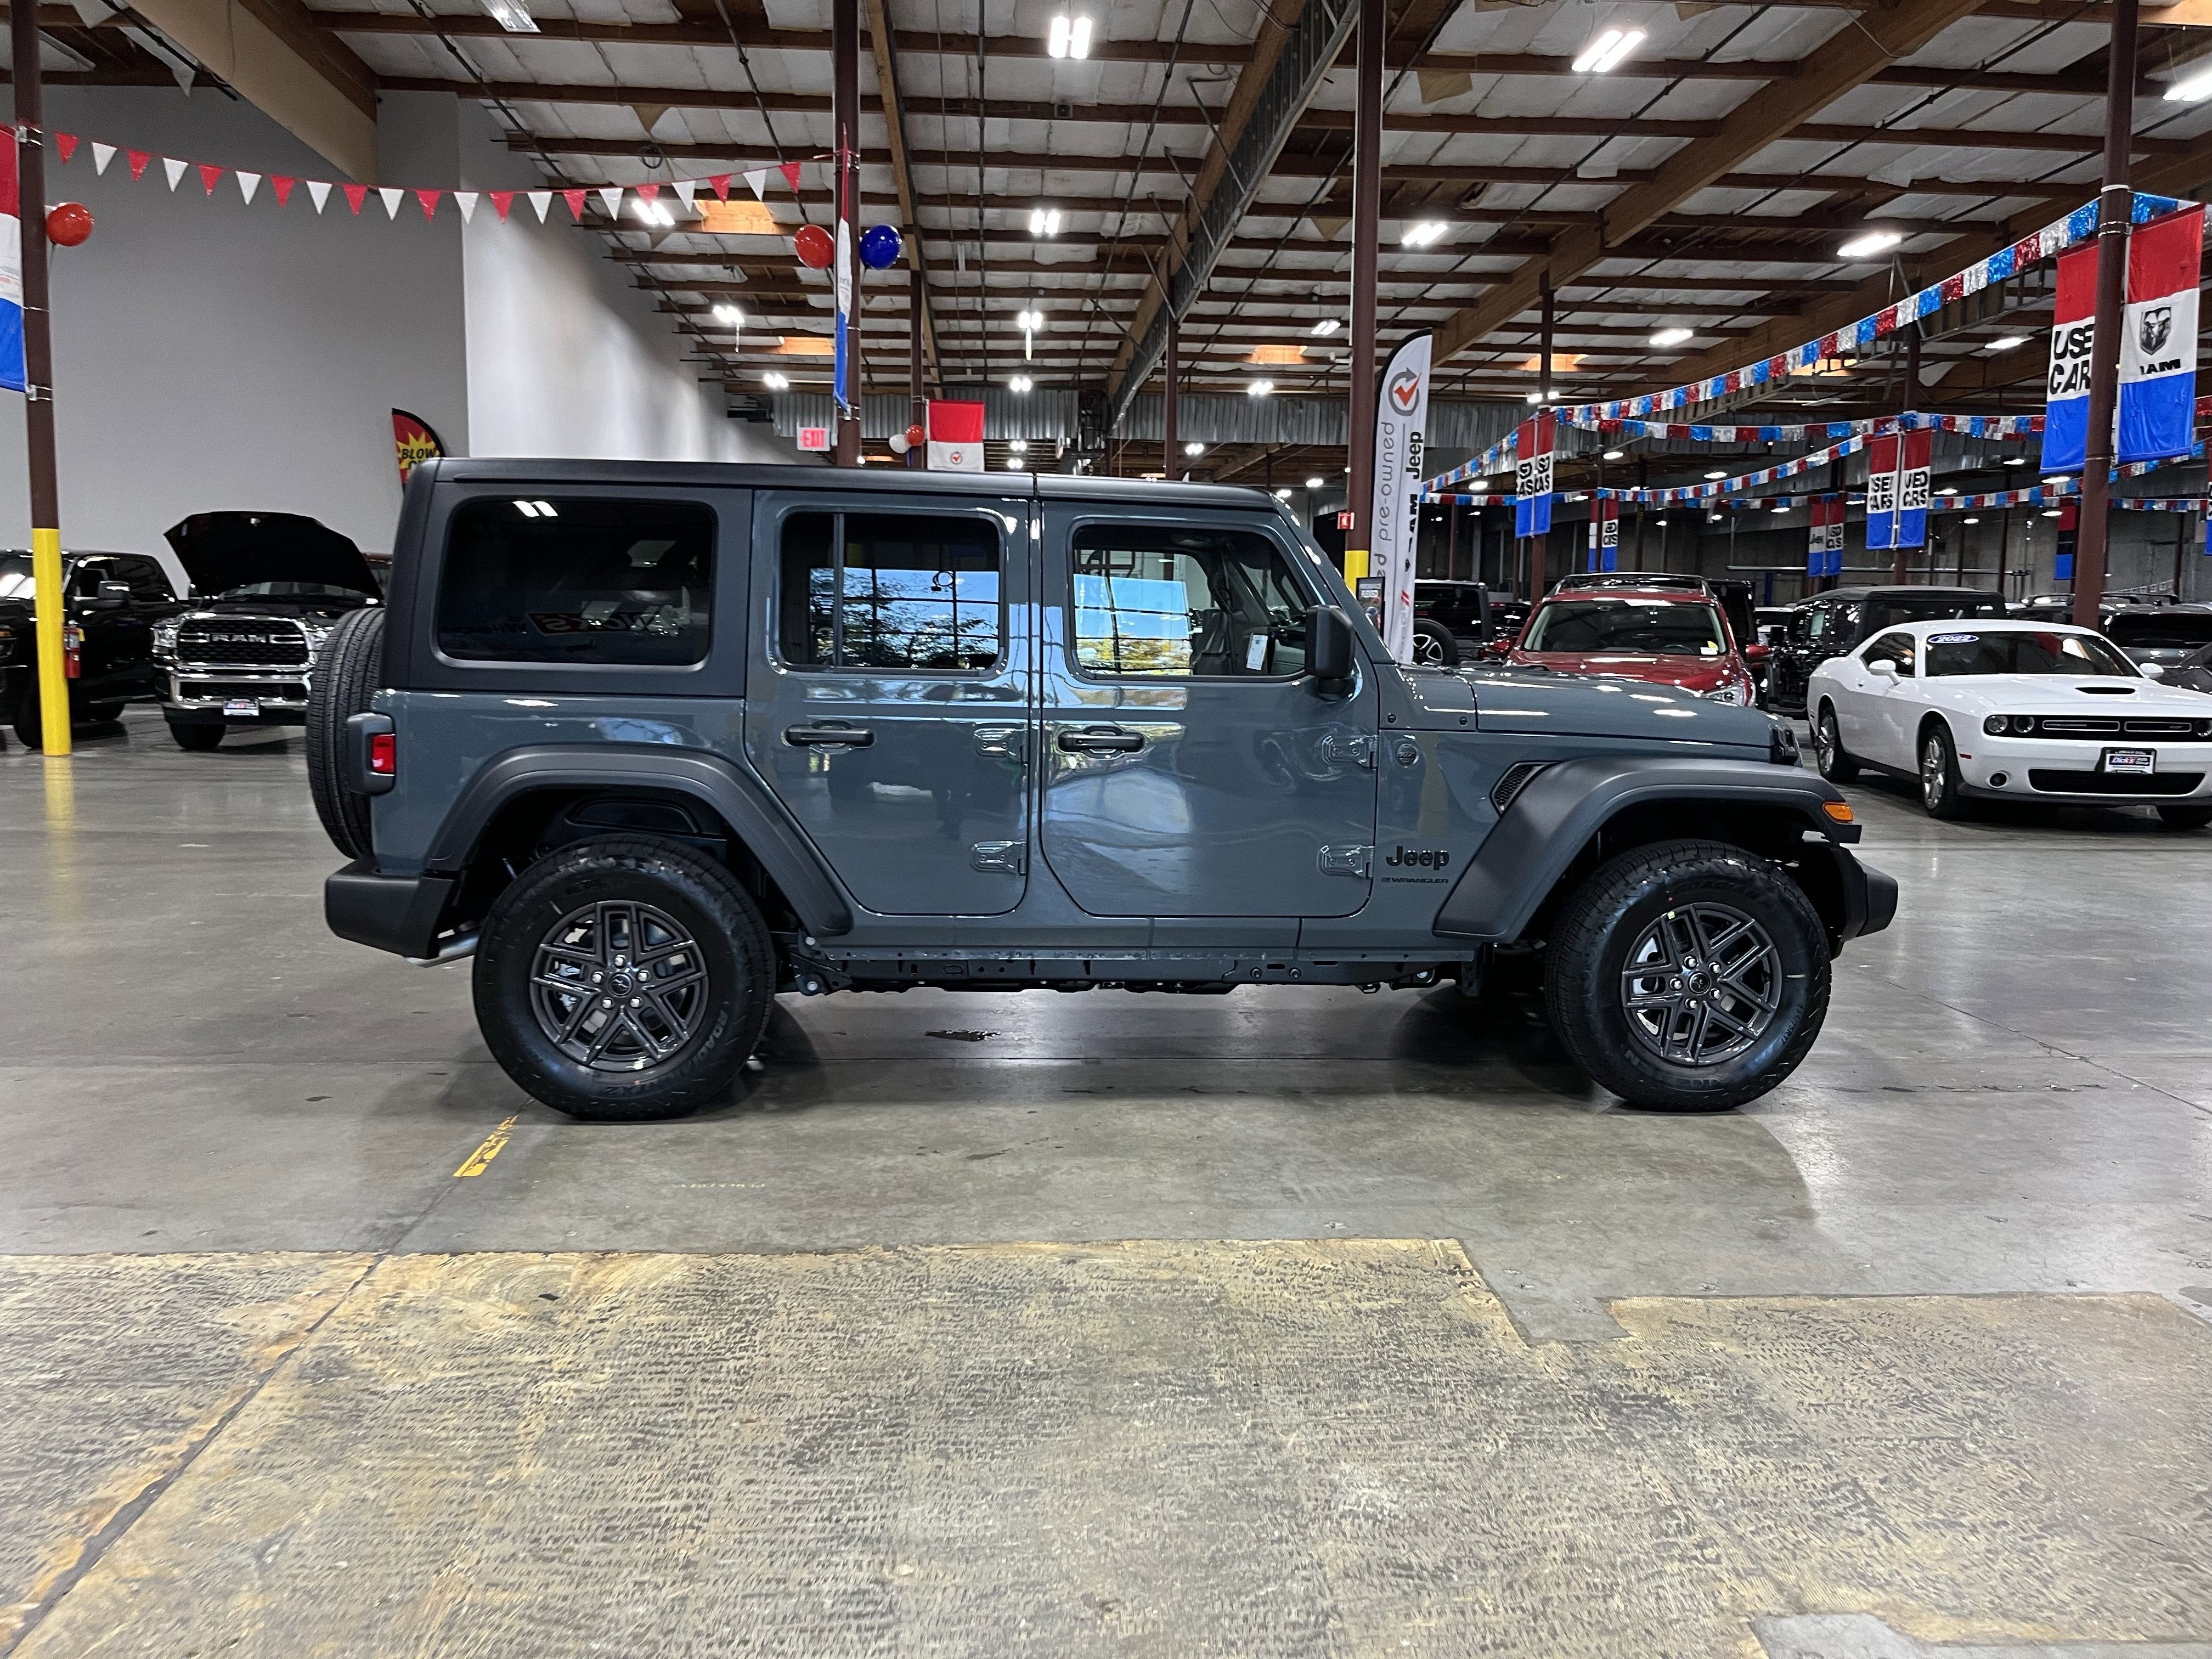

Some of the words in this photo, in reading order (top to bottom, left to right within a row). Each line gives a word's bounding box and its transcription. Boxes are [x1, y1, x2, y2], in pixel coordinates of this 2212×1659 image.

[2053, 324, 2096, 359] USE
[2050, 359, 2091, 394] CAR
[402, 448, 436, 459] BLOW
[803, 430, 825, 448] EXIT
[1406, 431, 1423, 479] Jeep
[1379, 422, 1395, 541] pre-owned
[1408, 494, 1418, 552] AM
[212, 634, 267, 643] RAM
[1386, 846, 1450, 871] Jeep
